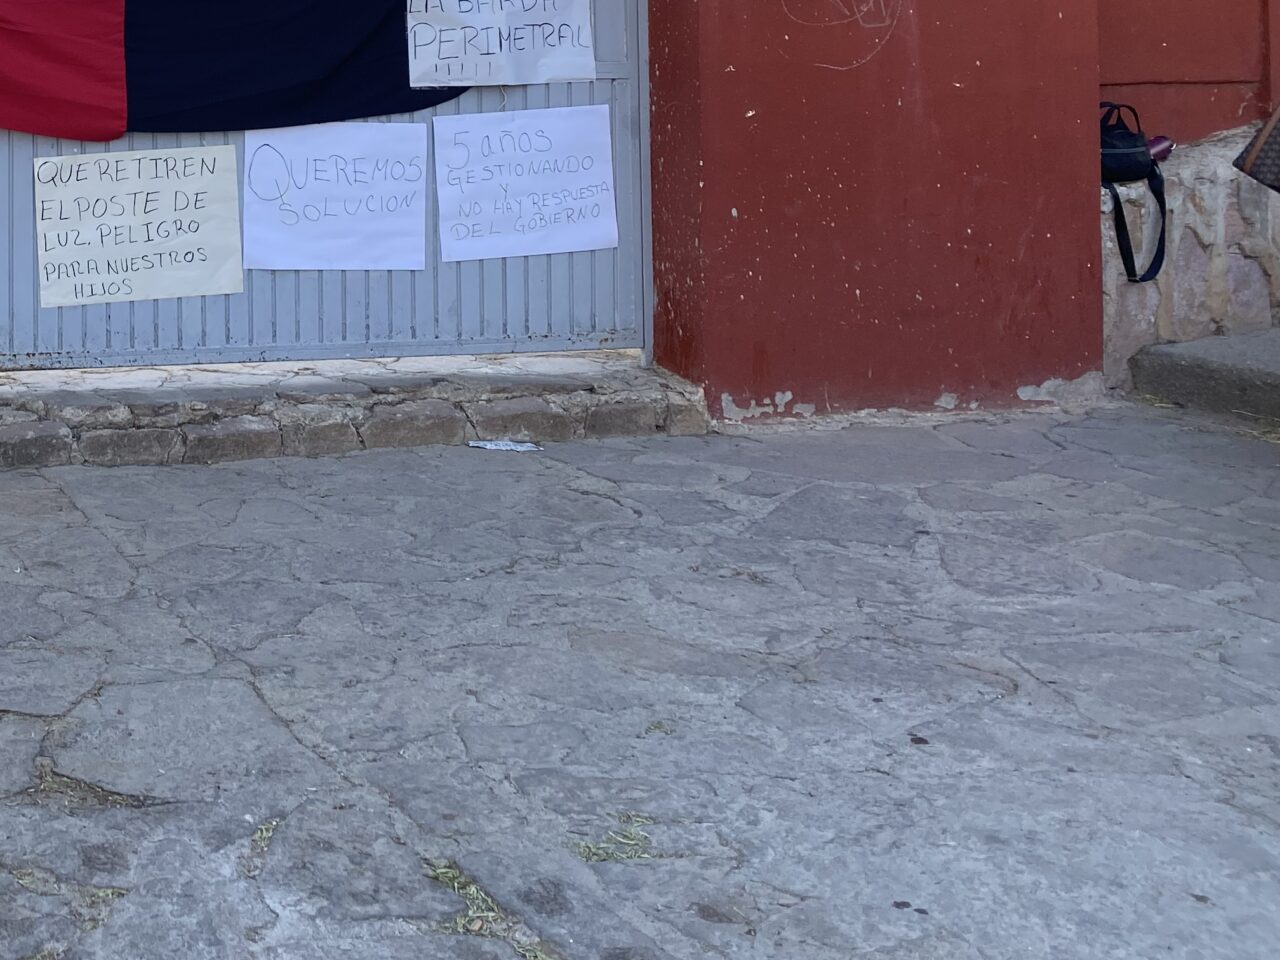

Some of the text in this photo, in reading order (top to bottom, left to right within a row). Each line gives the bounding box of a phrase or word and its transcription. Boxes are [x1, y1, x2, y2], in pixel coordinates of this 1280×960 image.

[409, 21, 591, 61] PERIMETRAL
[446, 131, 470, 170] 5
[37, 156, 217, 187] QUE RETIREN
[248, 143, 423, 205] QUEREMOS
[447, 155, 594, 194] GESTIONANDO
[41, 190, 208, 222] EL POSTE DE
[278, 190, 416, 226] SOLUCION
[458, 181, 610, 218] NO HAY RESPUESTA
[96, 218, 200, 248] PELIGRO
[450, 203, 601, 241] DEL GOBIERNO
[43, 247, 209, 282] PARA NUESTROS
[73, 279, 133, 300] HIJOS
